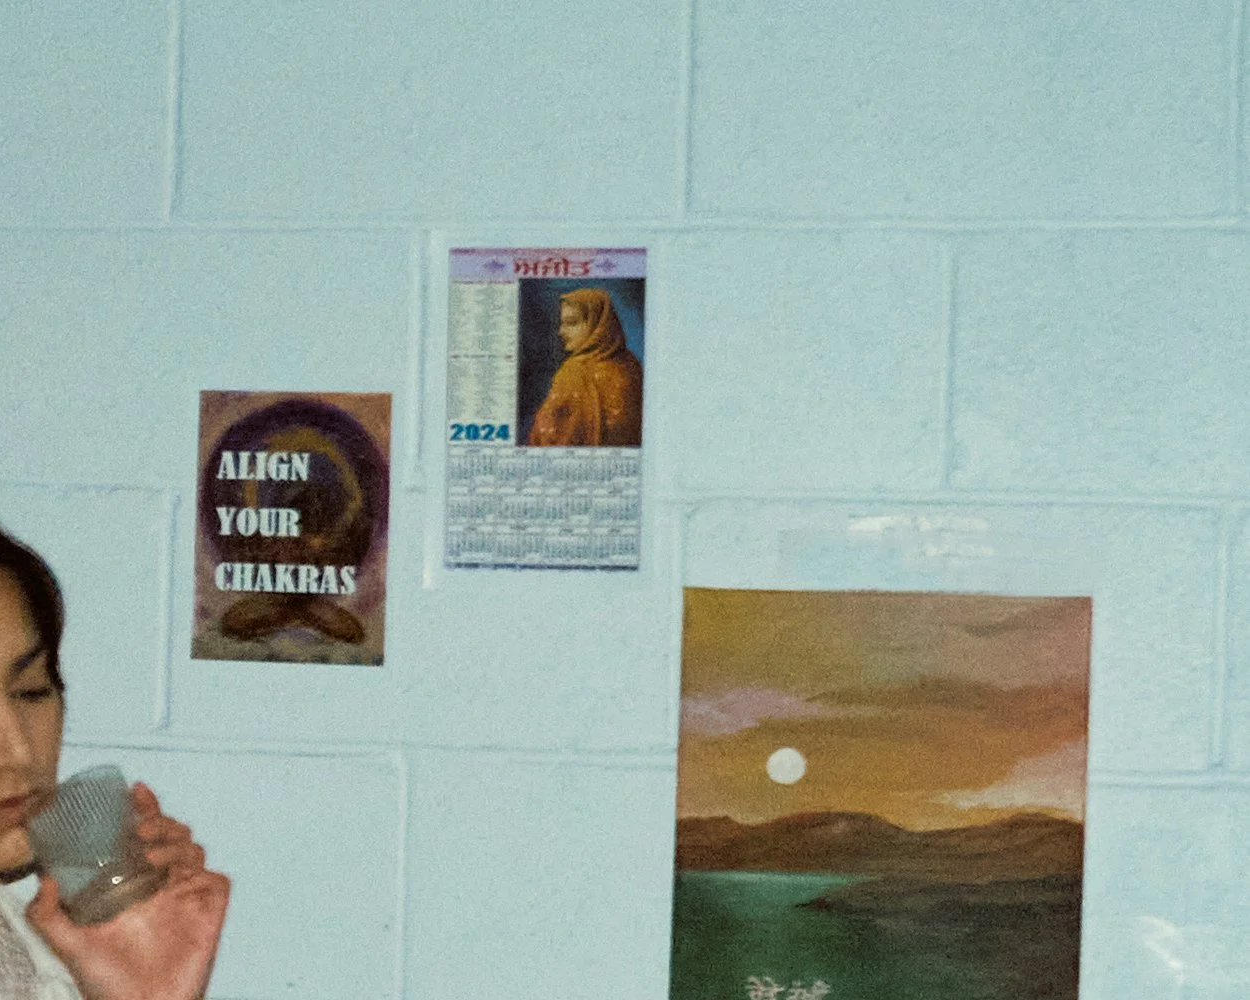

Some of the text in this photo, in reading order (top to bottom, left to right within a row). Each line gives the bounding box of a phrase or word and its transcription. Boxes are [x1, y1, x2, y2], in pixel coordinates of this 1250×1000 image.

[449, 422, 511, 442] 2024
[216, 450, 311, 482] ALIGN
[216, 506, 301, 538] YOUR
[214, 562, 358, 595] CHAKRAS
